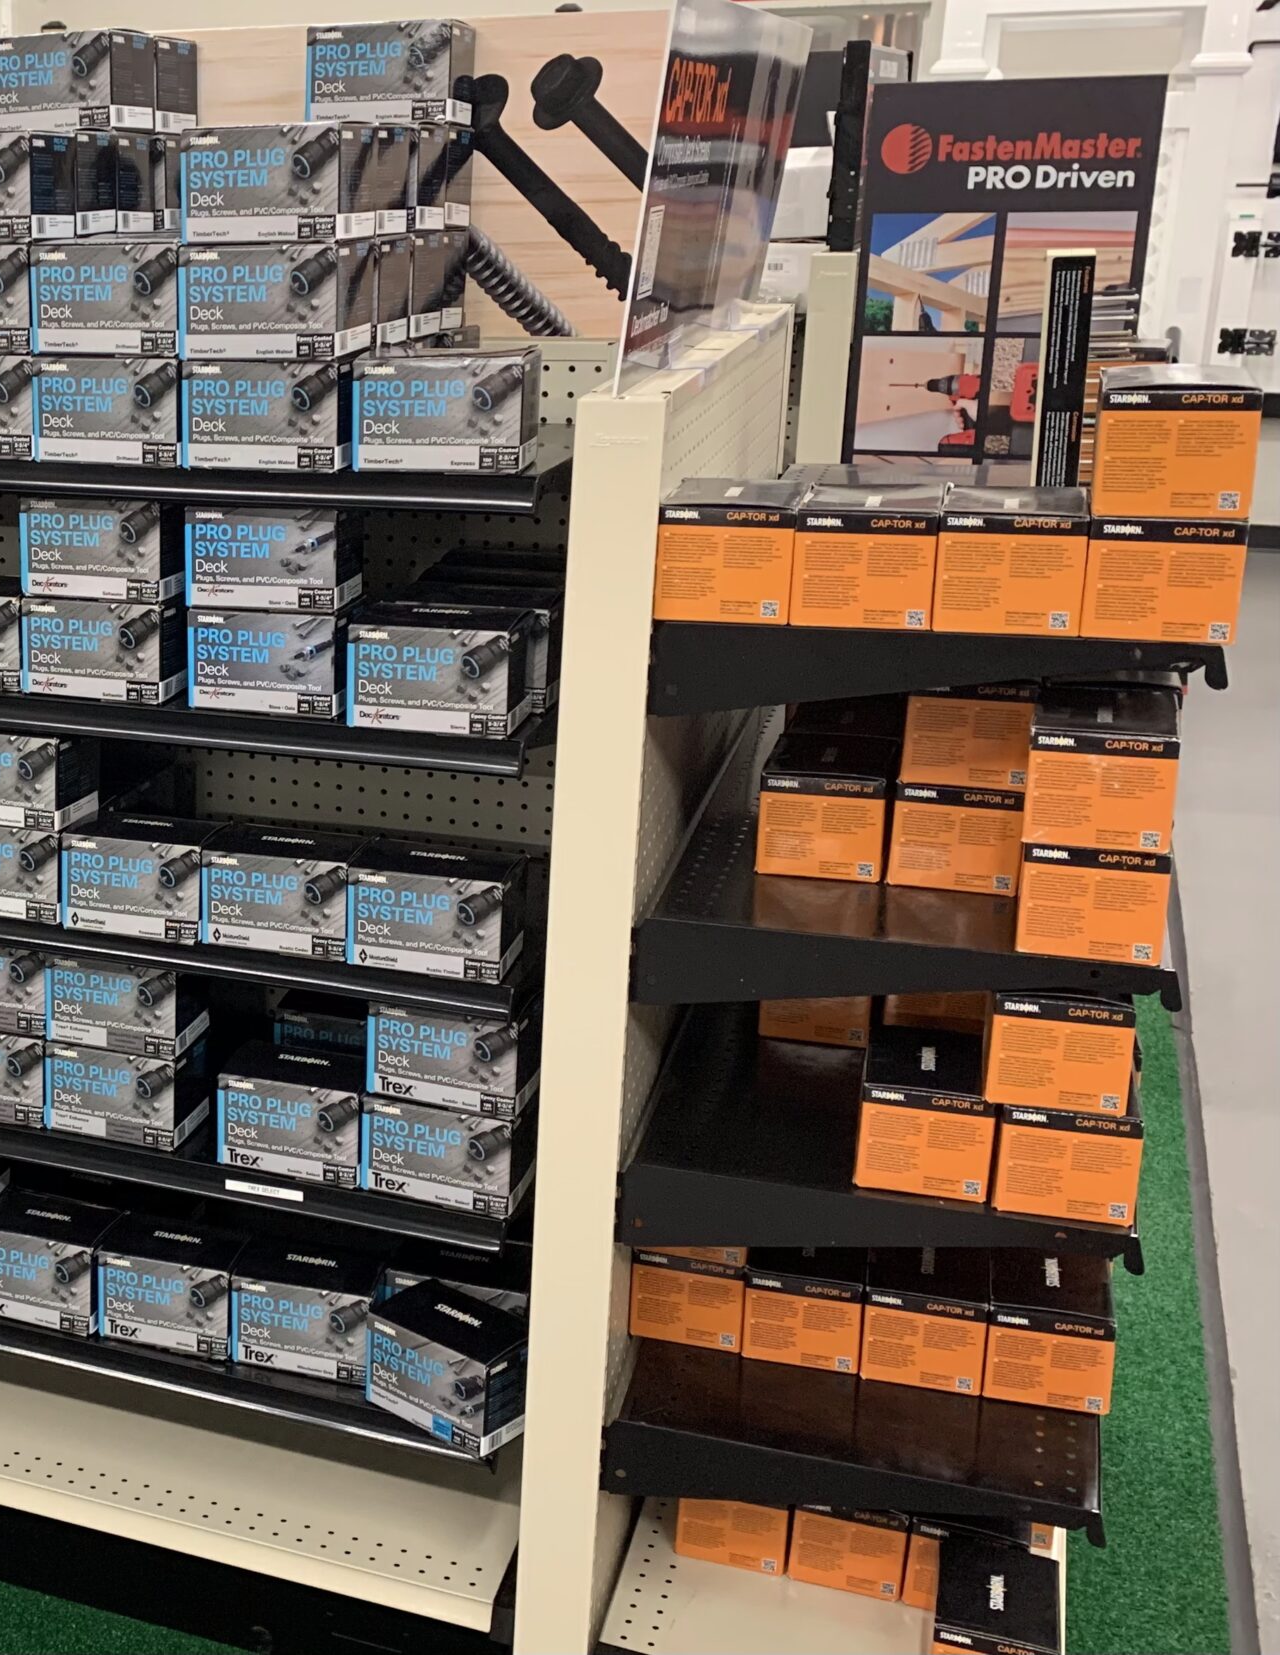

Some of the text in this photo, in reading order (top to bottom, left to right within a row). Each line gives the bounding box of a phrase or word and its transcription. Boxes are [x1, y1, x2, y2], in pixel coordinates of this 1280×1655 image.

[315, 43, 402, 60] PRO PLUG
[315, 61, 386, 78] SYSTEM
[315, 81, 346, 93] Deck
[938, 132, 1142, 163] FastenMaster
[190, 149, 285, 168] PRO PLUG
[190, 170, 268, 188] SYSTEM
[967, 165, 1136, 191] PRO Driven
[190, 192, 224, 206] Deck
[190, 266, 284, 282] PRO PLUG
[190, 286, 266, 302] SYSTEM
[190, 306, 223, 320] Deck
[364, 380, 465, 397] PRO PLUG
[1182, 393, 1245, 404] CAP-TOR xd
[364, 400, 446, 416] SYSTEM
[364, 420, 399, 434] Deck
[726, 511, 779, 522] CAP-TOR xd
[871, 519, 926, 530] CAP-TOR xd
[1014, 518, 1072, 530] CAP-TOR xd
[1174, 527, 1235, 538] CAP-TOR xd
[359, 643, 454, 664] PRO PLUG
[359, 662, 437, 680] SYSTEM
[359, 680, 392, 694] Deck
[1106, 740, 1163, 752] CAP-TOR xd
[825, 783, 874, 793] CAP-TOR xd
[964, 794, 1015, 805] CAP-TOR xd
[1099, 854, 1156, 866] CAP-TOR xd
[358, 886, 450, 911] PRO PLUG
[358, 903, 433, 925] SYSTEM
[358, 920, 390, 936] Deck
[54, 972, 131, 992] PRO PLUG
[54, 986, 118, 1006] SYSTEM
[54, 1000, 83, 1015] Deck
[1068, 1008, 1123, 1021] CAP-TOR xd
[373, 1117, 461, 1146] PRO PLUG
[1076, 1119, 1130, 1132] CAP-TOR xd
[373, 1134, 445, 1159] SYSTEM
[373, 1149, 404, 1166] Deck
[373, 1172, 406, 1194] Trex
[241, 1293, 322, 1320] PRO PLUG
[241, 1309, 308, 1332] SYSTEM
[241, 1323, 271, 1339] Deck
[1055, 1323, 1104, 1336] CAP-TOR xd
[243, 1344, 274, 1364] Trex
[374, 1334, 445, 1376] PRO PLUG
[373, 1364, 398, 1385] Deck
[374, 1350, 431, 1386] SYSTEM
